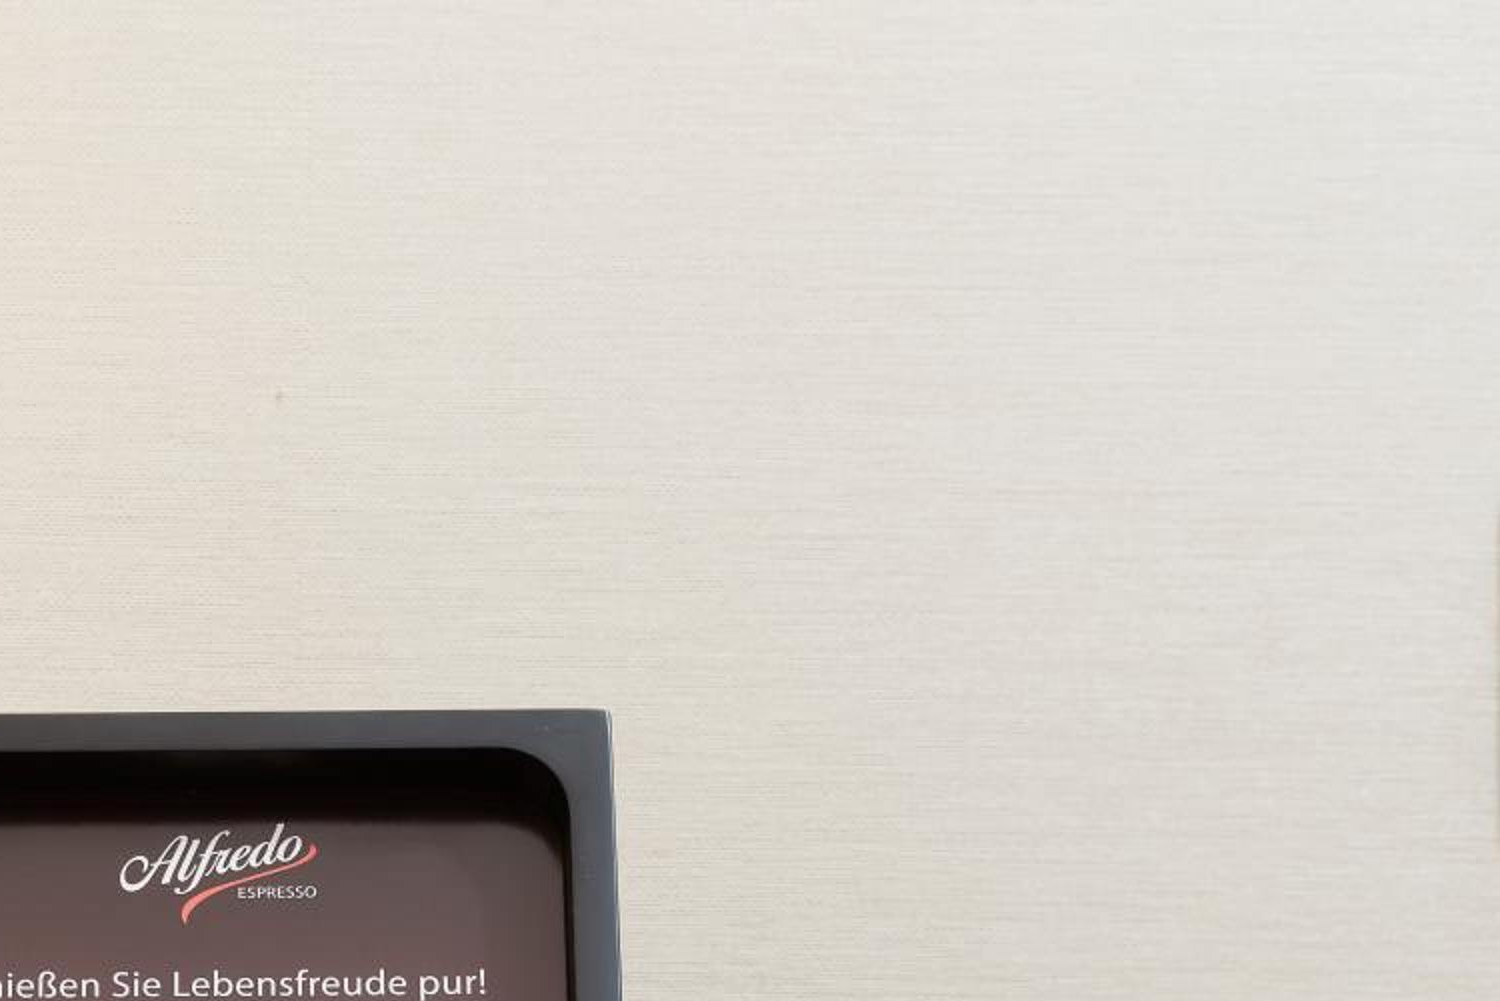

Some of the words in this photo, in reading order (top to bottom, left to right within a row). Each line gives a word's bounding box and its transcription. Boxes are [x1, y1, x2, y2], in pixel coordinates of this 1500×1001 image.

[119, 822, 304, 896] Alfredo
[237, 885, 317, 900] ESPRESSO
[111, 970, 162, 998] Sie
[172, 967, 408, 998] Lebensfreude
